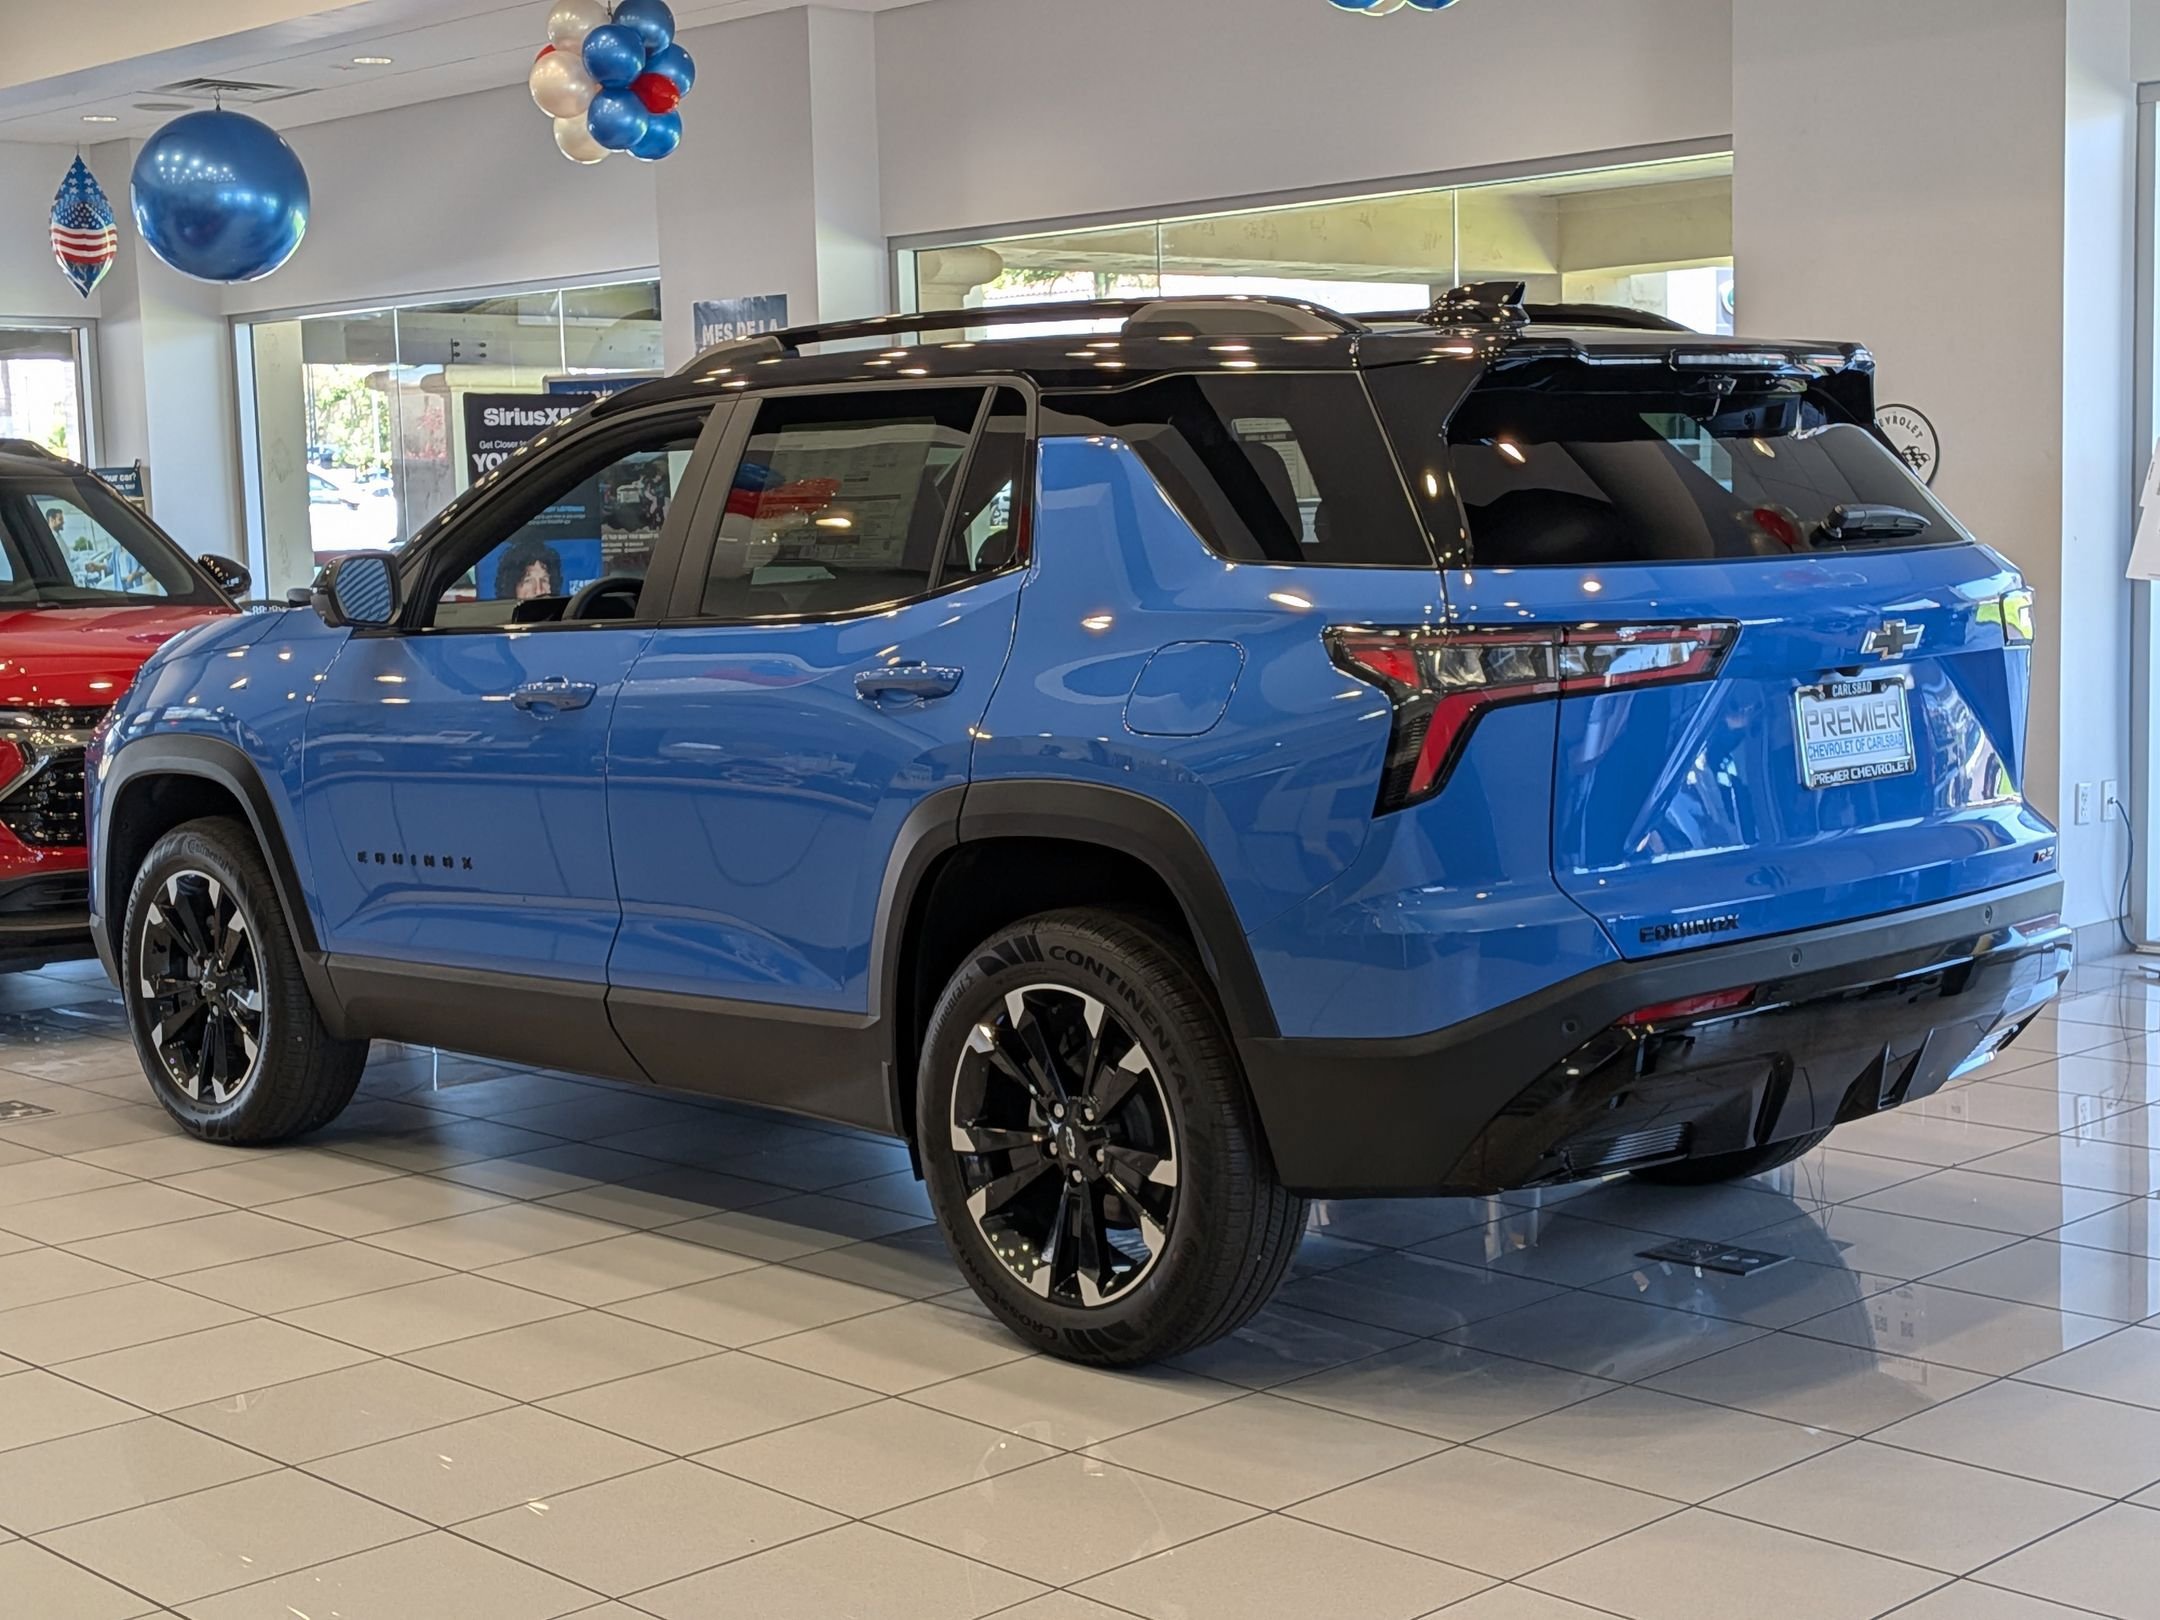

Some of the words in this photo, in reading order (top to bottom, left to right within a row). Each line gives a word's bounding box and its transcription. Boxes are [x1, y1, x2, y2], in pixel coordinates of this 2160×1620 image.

[702, 323, 734, 346] MES
[1878, 414, 1923, 439] EVROLET
[479, 440, 494, 450] Get
[1831, 681, 1873, 698] CARLSBAD
[1804, 700, 1901, 740] PREMIER
[1808, 739, 1854, 758] CHEVROLET
[1855, 738, 1866, 752] OF
[1866, 733, 1905, 750] CARLSBAD
[1812, 769, 1850, 786] PREMIER
[1850, 760, 1910, 780] CHEVROLET
[357, 850, 473, 870] EQUINOX
[1639, 913, 1740, 943] EQUINOX
[1048, 944, 1194, 1109] CONTINENTAL
